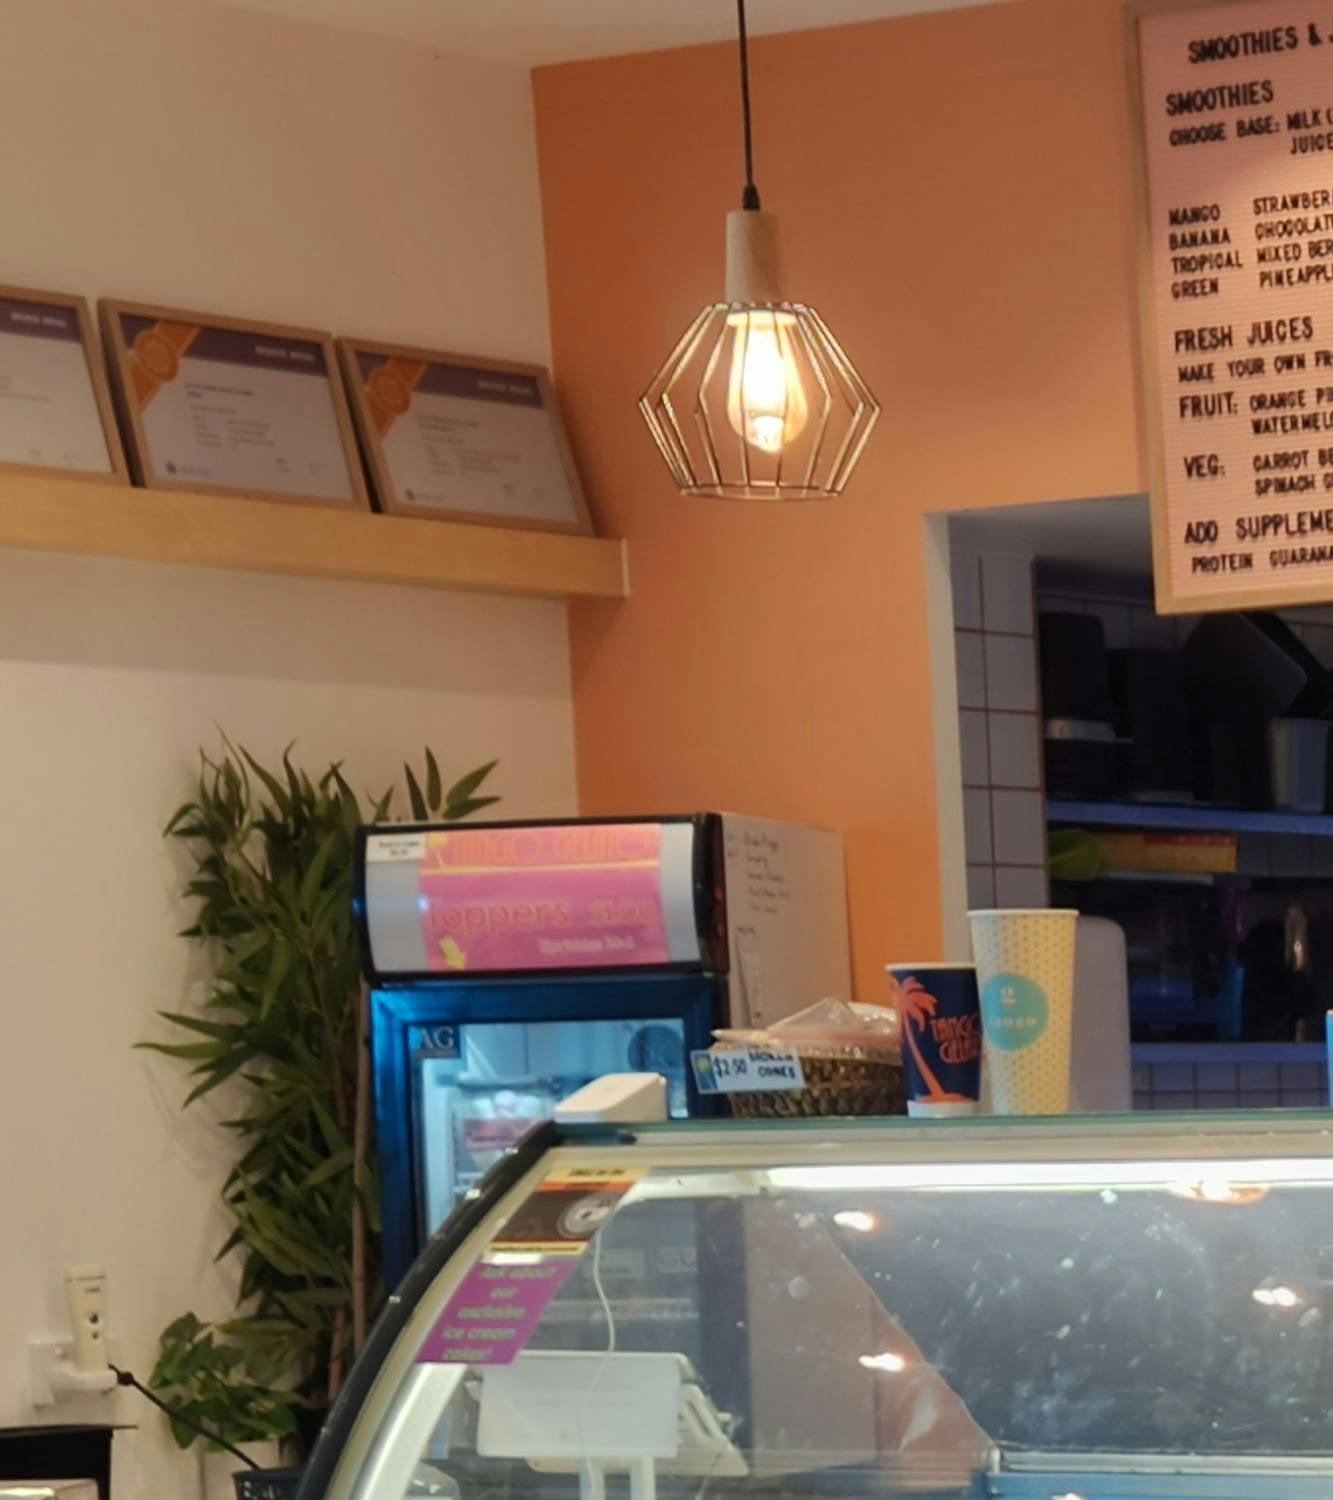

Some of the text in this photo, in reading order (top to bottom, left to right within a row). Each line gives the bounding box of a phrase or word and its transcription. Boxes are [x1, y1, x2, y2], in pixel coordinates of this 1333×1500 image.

[1188, 26, 1298, 64] SMOOTHIES
[1307, 23, 1322, 46] &
[1165, 80, 1275, 117] SMOOTHIES
[1169, 121, 1226, 147] CHOOSE
[1236, 116, 1281, 138] BASE:
[1286, 108, 1321, 132] MILK
[1168, 204, 1221, 227] MANGO
[1168, 227, 1230, 252] BANANA
[1171, 250, 1243, 275] TROPICAL
[1257, 244, 1302, 265] MIXED
[1171, 277, 1219, 300] GREEN
[1174, 325, 1233, 354] FRESH
[1247, 316, 1314, 347] JUICES
[1178, 362, 1215, 383] MAKE
[1228, 356, 1266, 378] YOUR
[1274, 353, 1307, 375] OWN
[1179, 392, 1239, 419] FRUIT:
[1249, 389, 1307, 413] ORANGE
[1183, 455, 1226, 479] VEG:
[1252, 451, 1309, 474] CARROT
[1254, 473, 1316, 497] SPINACH
[1191, 550, 1253, 575] PROTEIN
